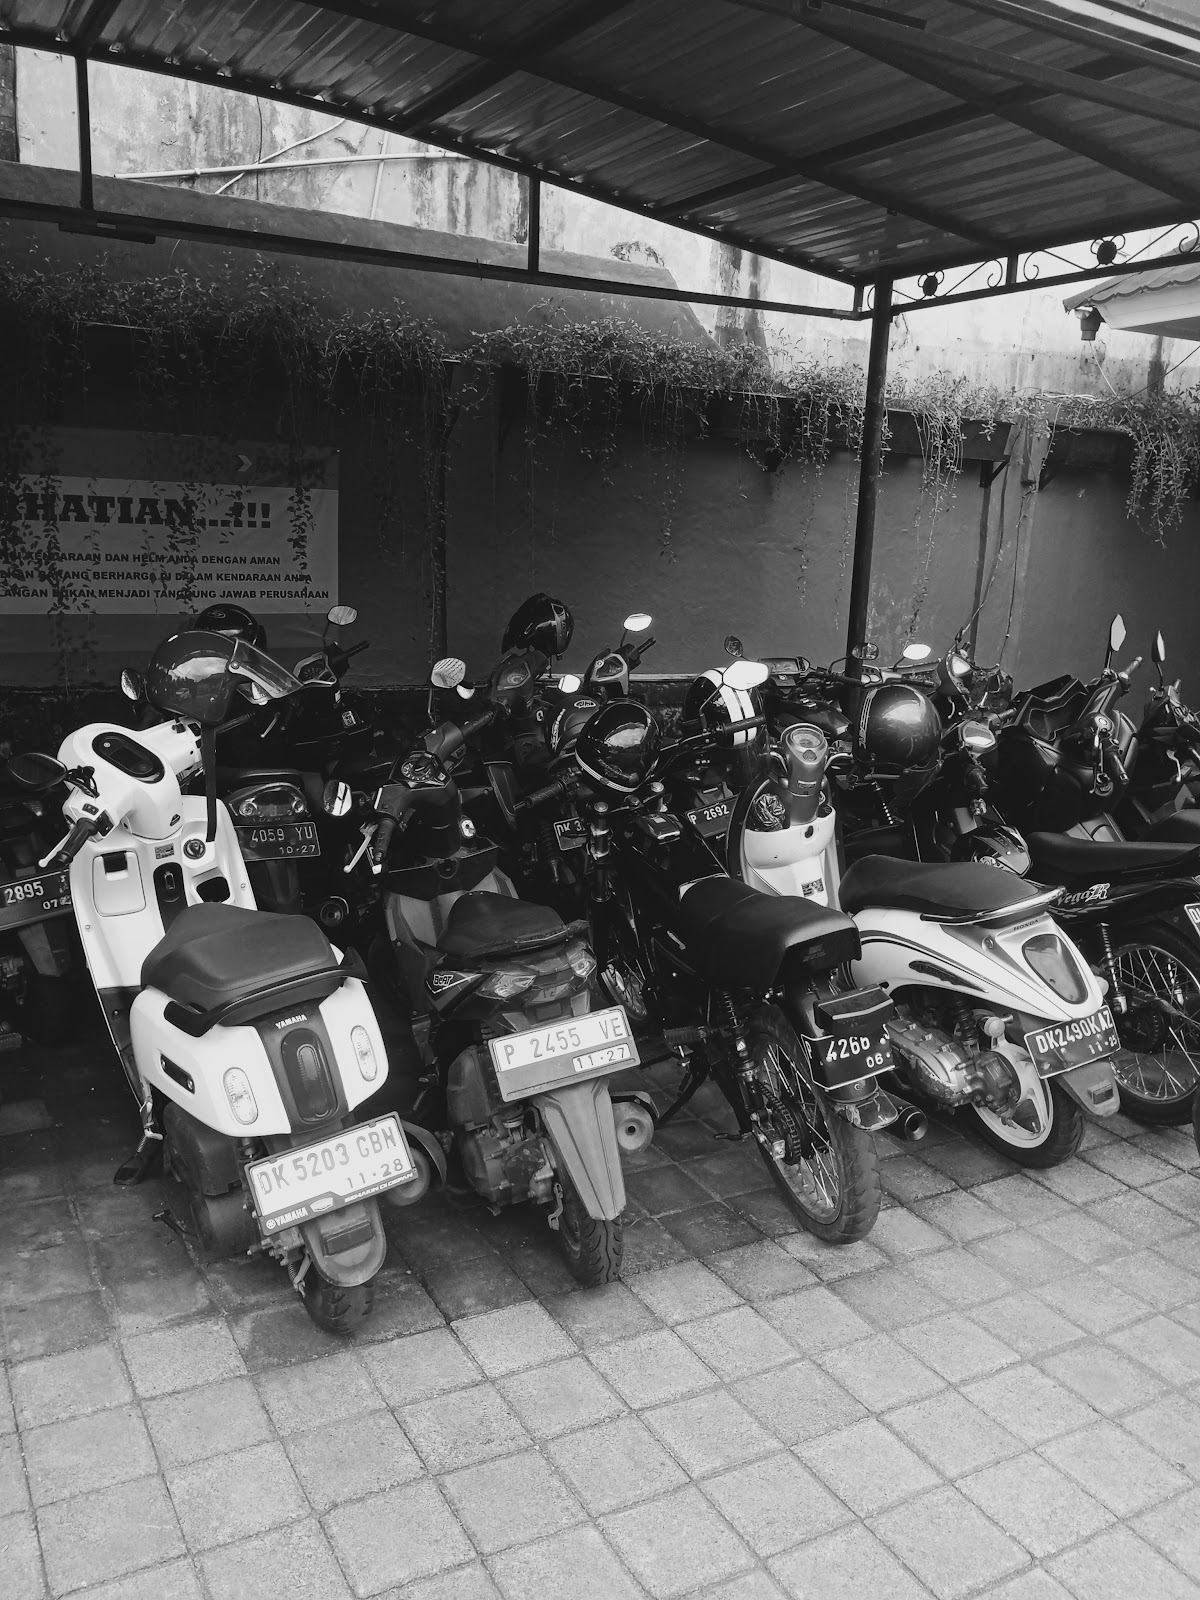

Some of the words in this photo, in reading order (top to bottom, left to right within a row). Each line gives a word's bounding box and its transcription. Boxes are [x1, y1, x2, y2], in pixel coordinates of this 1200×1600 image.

[105, 553, 129, 562] DAN
[201, 556, 247, 564] DENGAN
[250, 557, 280, 565] AMAN
[92, 571, 156, 580] BERHARG
[216, 573, 281, 582] KENDARAAN
[98, 589, 150, 598] MENJADI
[219, 590, 257, 599] JAWAB
[259, 590, 329, 599] PERUSAHAAN
[703, 804, 730, 821] 2692
[251, 828, 285, 842] 4059
[295, 825, 313, 841] YU
[4, 881, 44, 904] 2895
[274, 1014, 308, 1030] YAMAHA
[503, 1043, 515, 1065] P
[529, 1027, 581, 1058] 2455
[598, 1017, 623, 1040] VE
[257, 1163, 291, 1195] DK
[292, 1143, 350, 1181] 5203
[274, 1206, 309, 1227] YAMAHA
